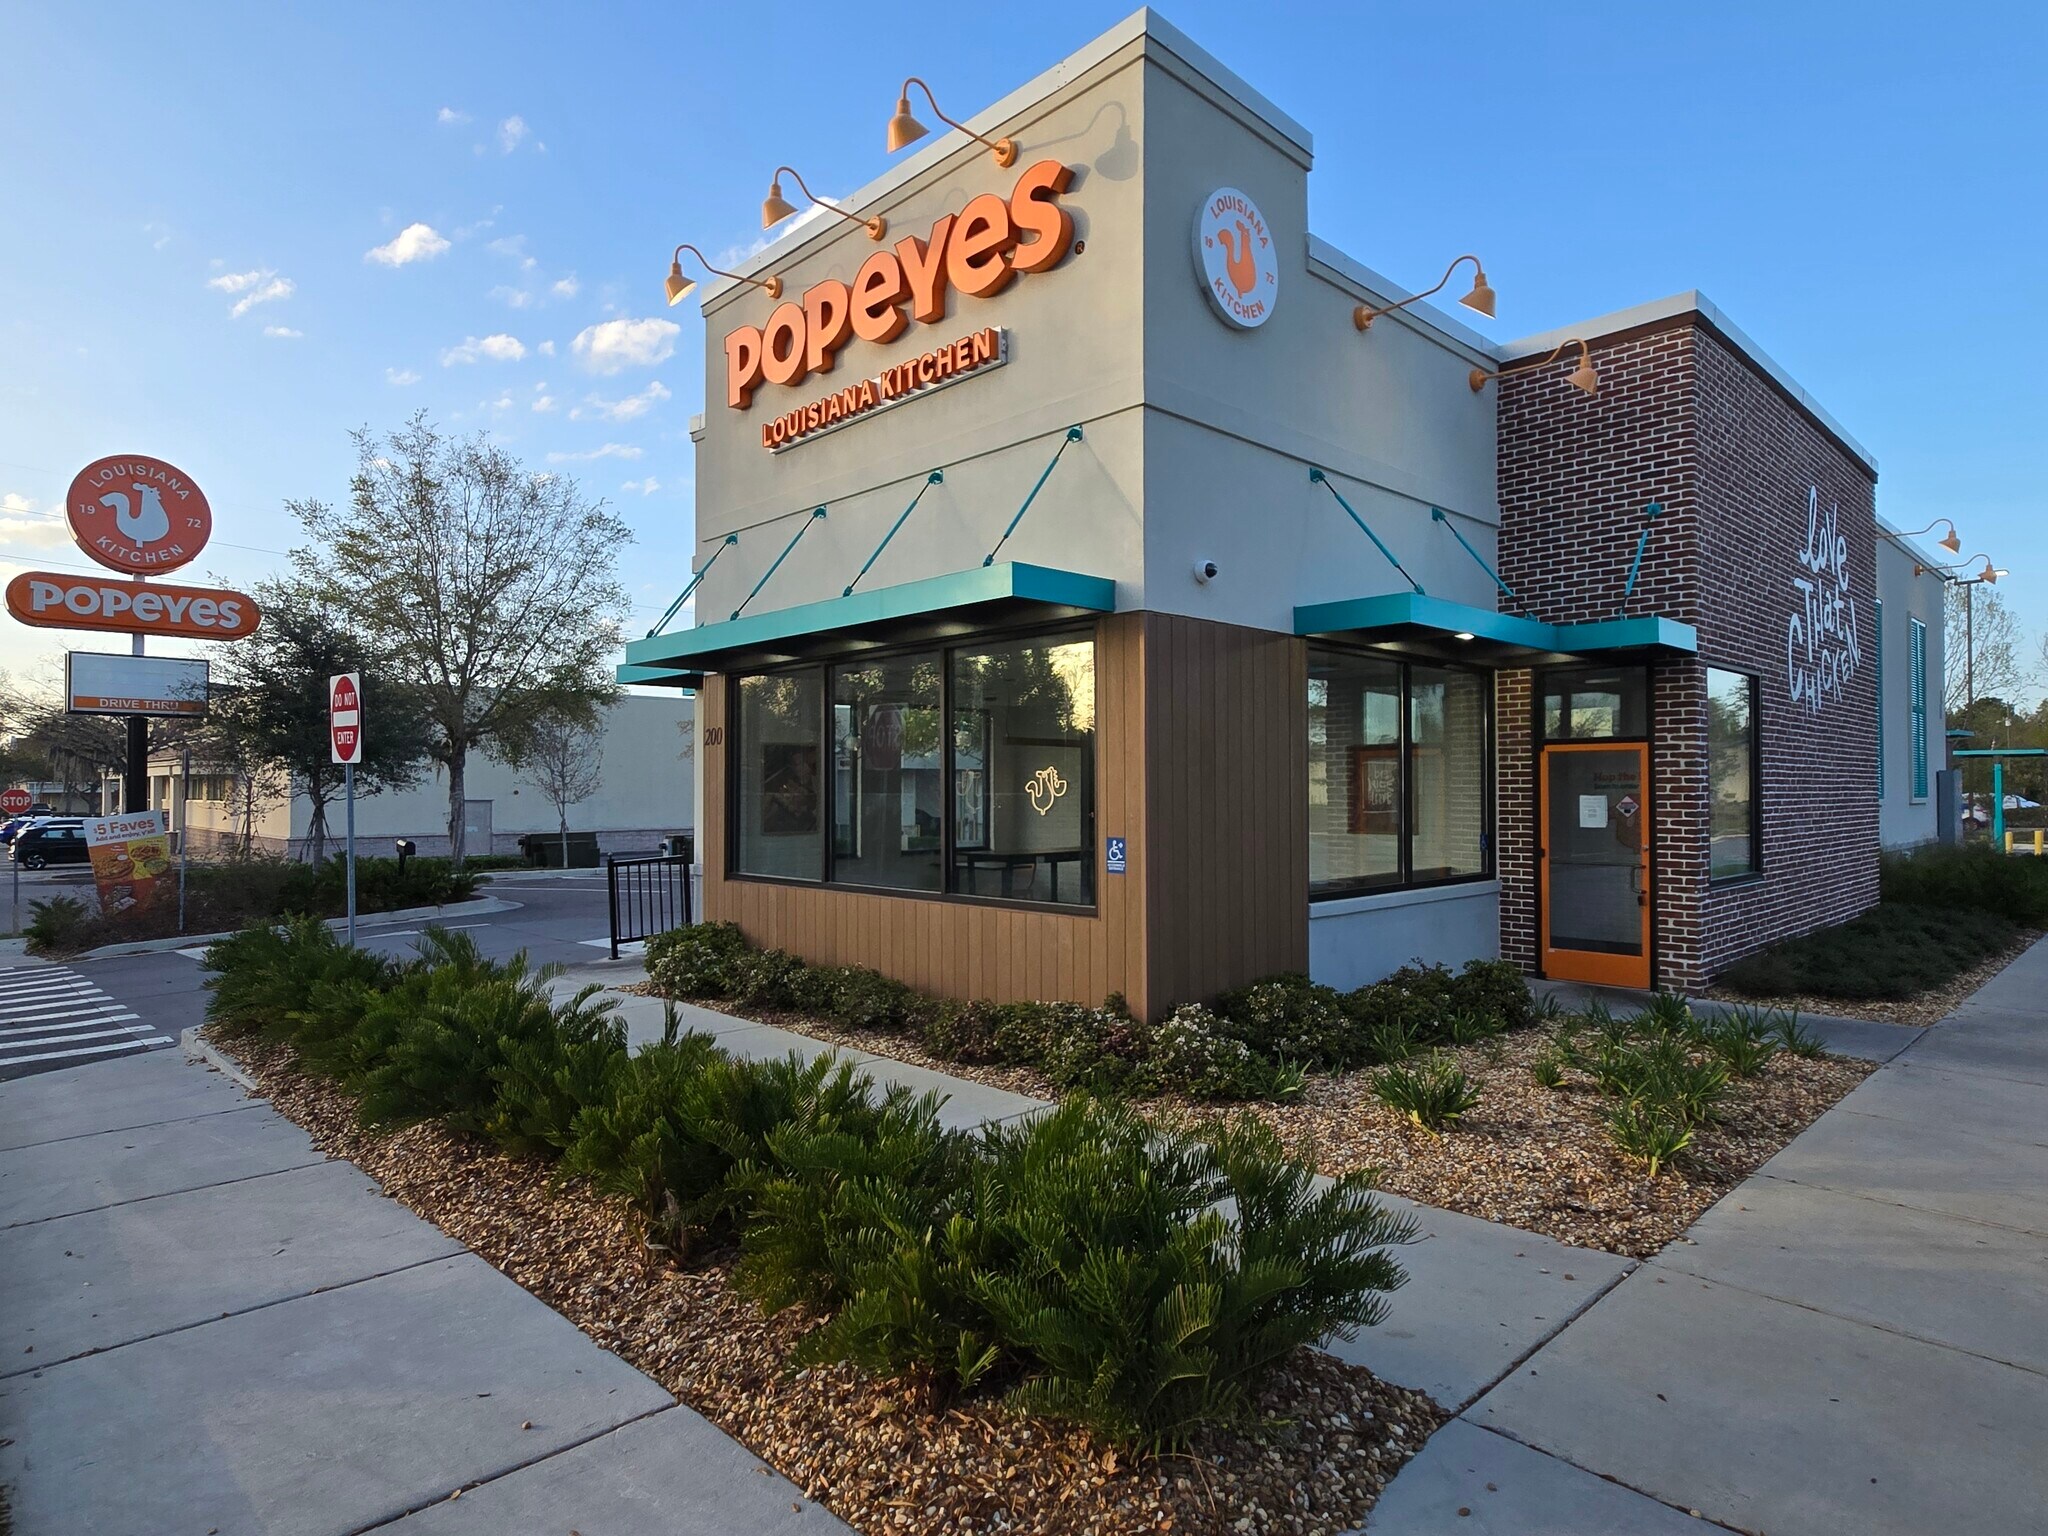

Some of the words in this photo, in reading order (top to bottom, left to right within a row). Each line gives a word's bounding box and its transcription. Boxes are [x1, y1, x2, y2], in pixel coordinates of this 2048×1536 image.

[1210, 195, 1269, 249] LOUISIANA
[1204, 236, 1213, 249] 19
[1214, 277, 1265, 319] KITCHEN
[762, 379, 878, 448] LOUISIANA
[880, 328, 997, 400] KITCHEN
[88, 463, 190, 500] LOUISIANA
[79, 503, 96, 515] 19
[186, 517, 202, 528] 72
[96, 535, 184, 563] KITCHEN
[99, 698, 140, 709] DRIVE
[143, 700, 179, 710] THRU
[334, 693, 343, 707] DO
[344, 692, 355, 706] NOT
[337, 731, 354, 745] ENTER
[704, 726, 723, 746] 200
[2, 796, 31, 807] STOP
[93, 823, 107, 835] $5
[109, 818, 155, 834] Faves
